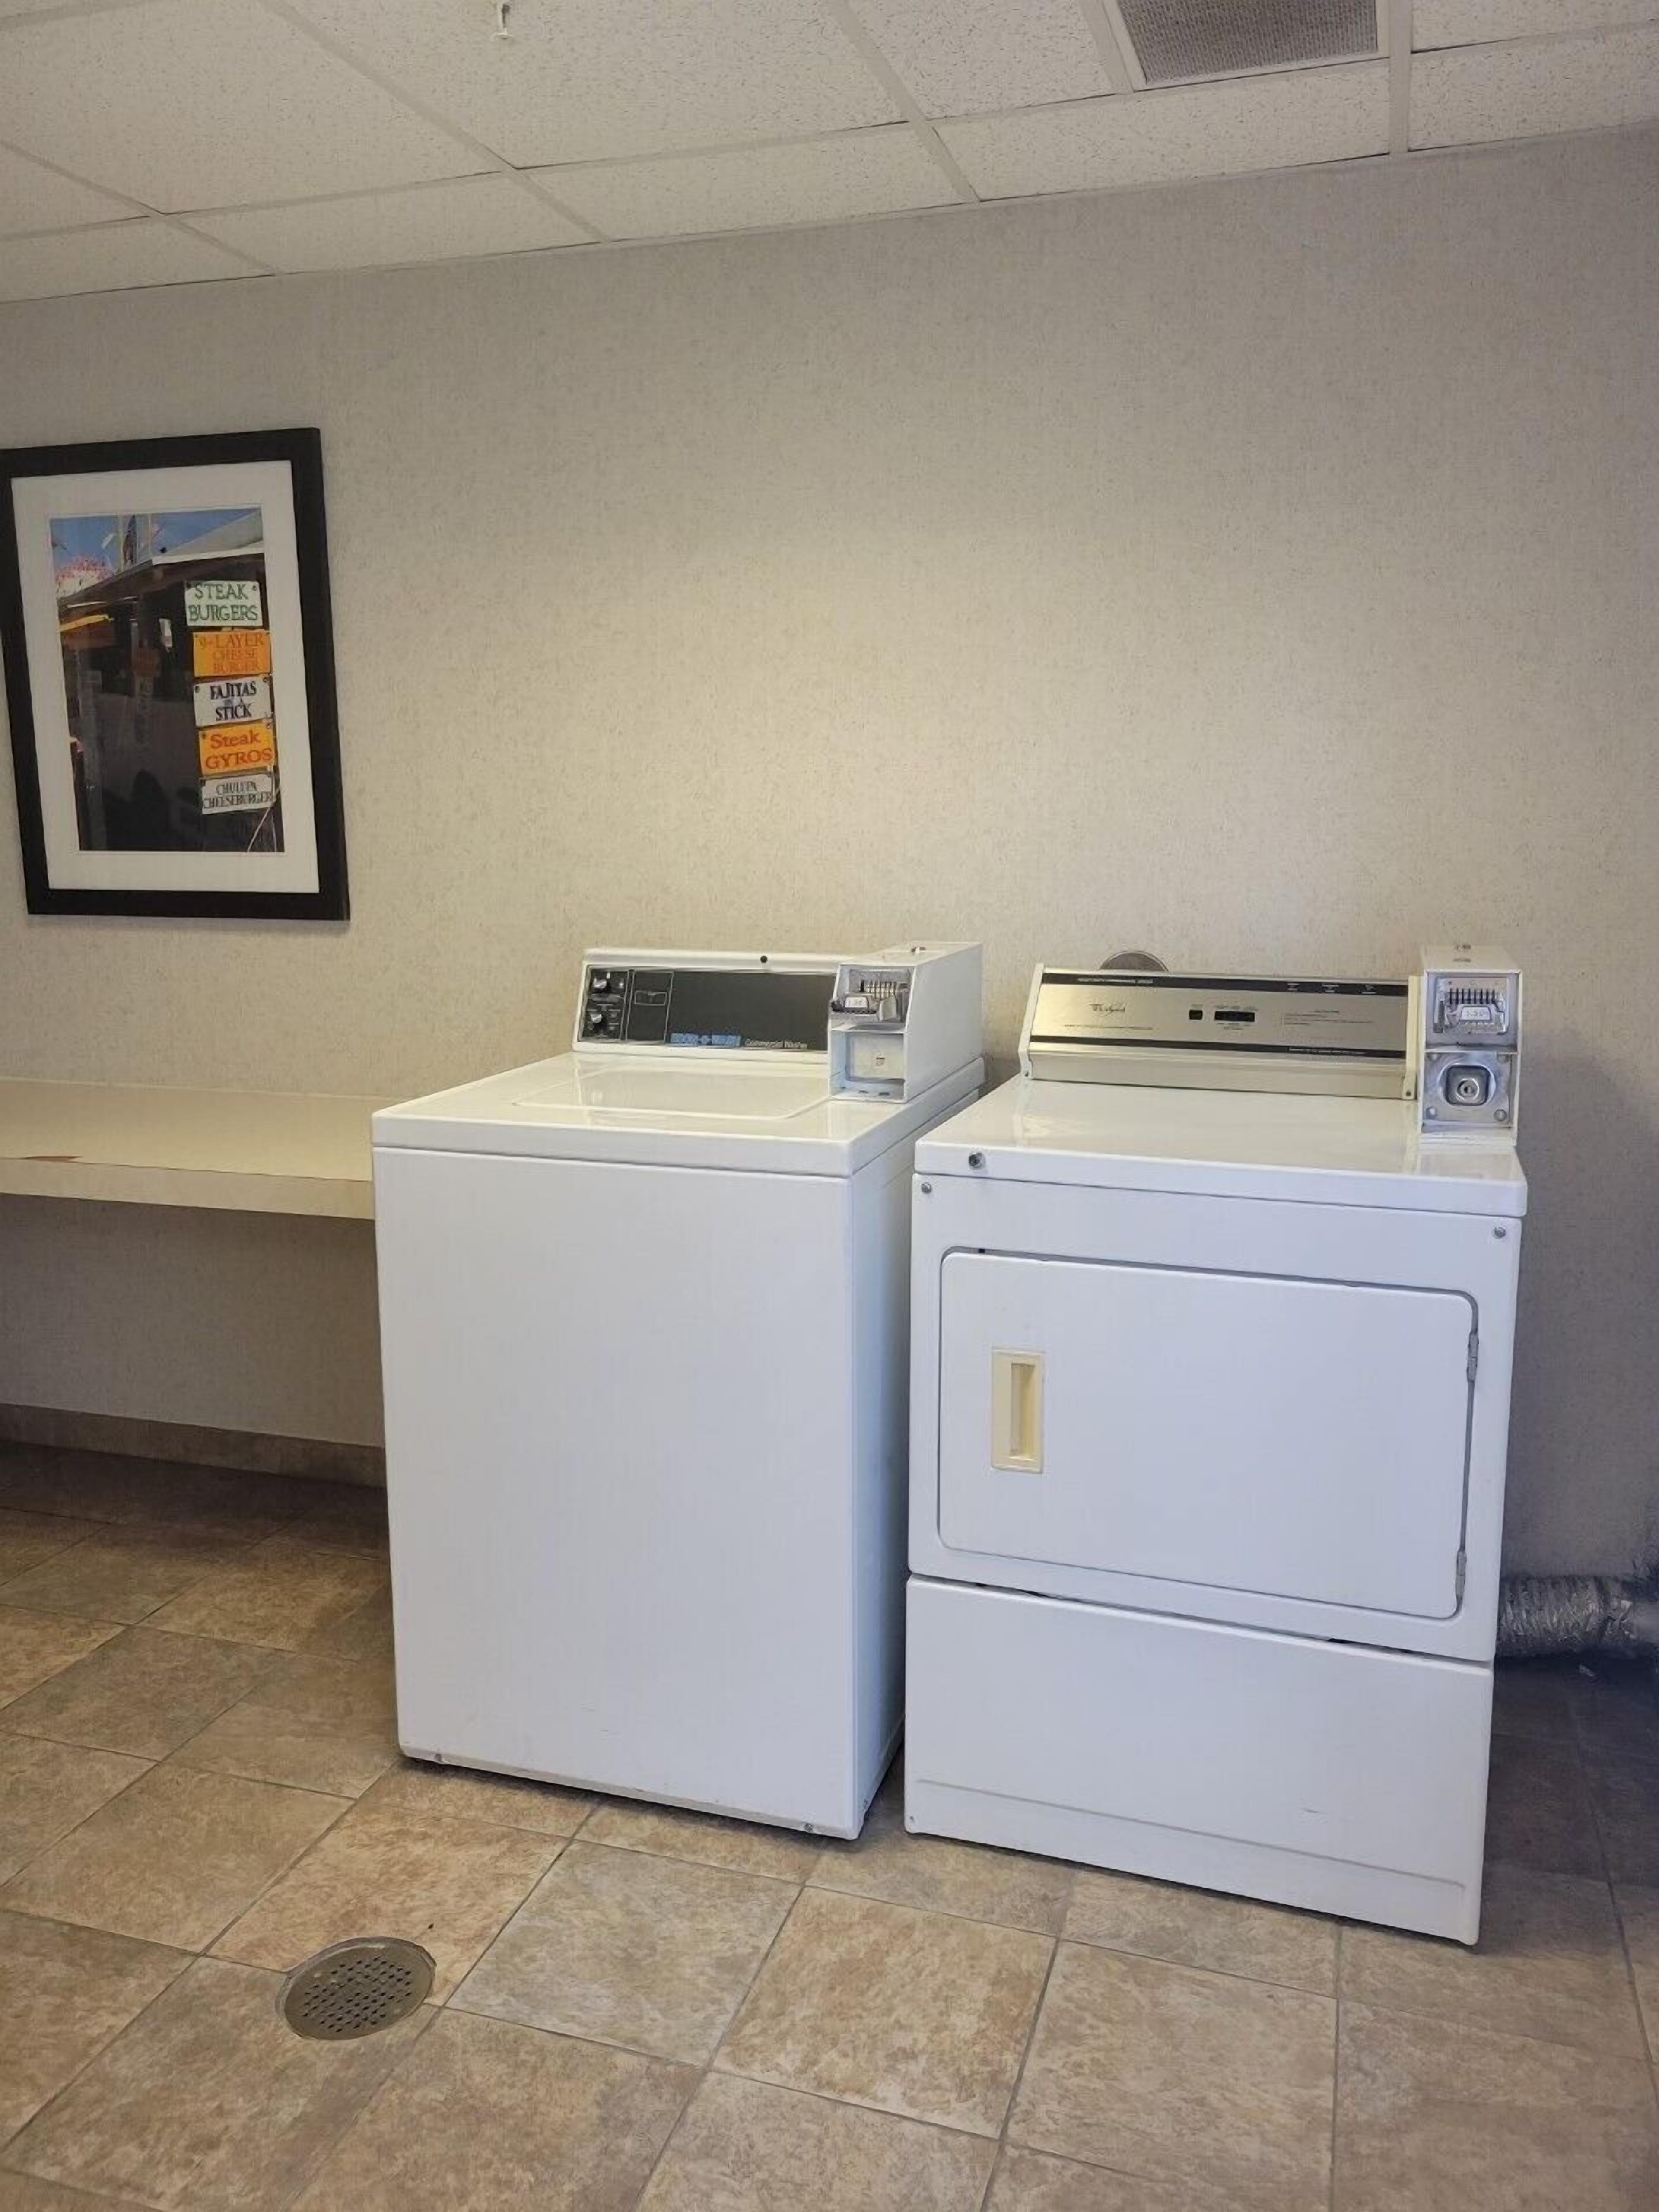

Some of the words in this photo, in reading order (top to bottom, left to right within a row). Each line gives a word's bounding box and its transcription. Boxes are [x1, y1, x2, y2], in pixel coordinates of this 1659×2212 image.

[195, 583, 249, 600] STEAK
[188, 605, 258, 621] BURGERS
[210, 681, 257, 700] FAJITAS
[216, 702, 255, 721] STICK
[210, 729, 261, 749] Steak
[205, 748, 272, 769] GYROS
